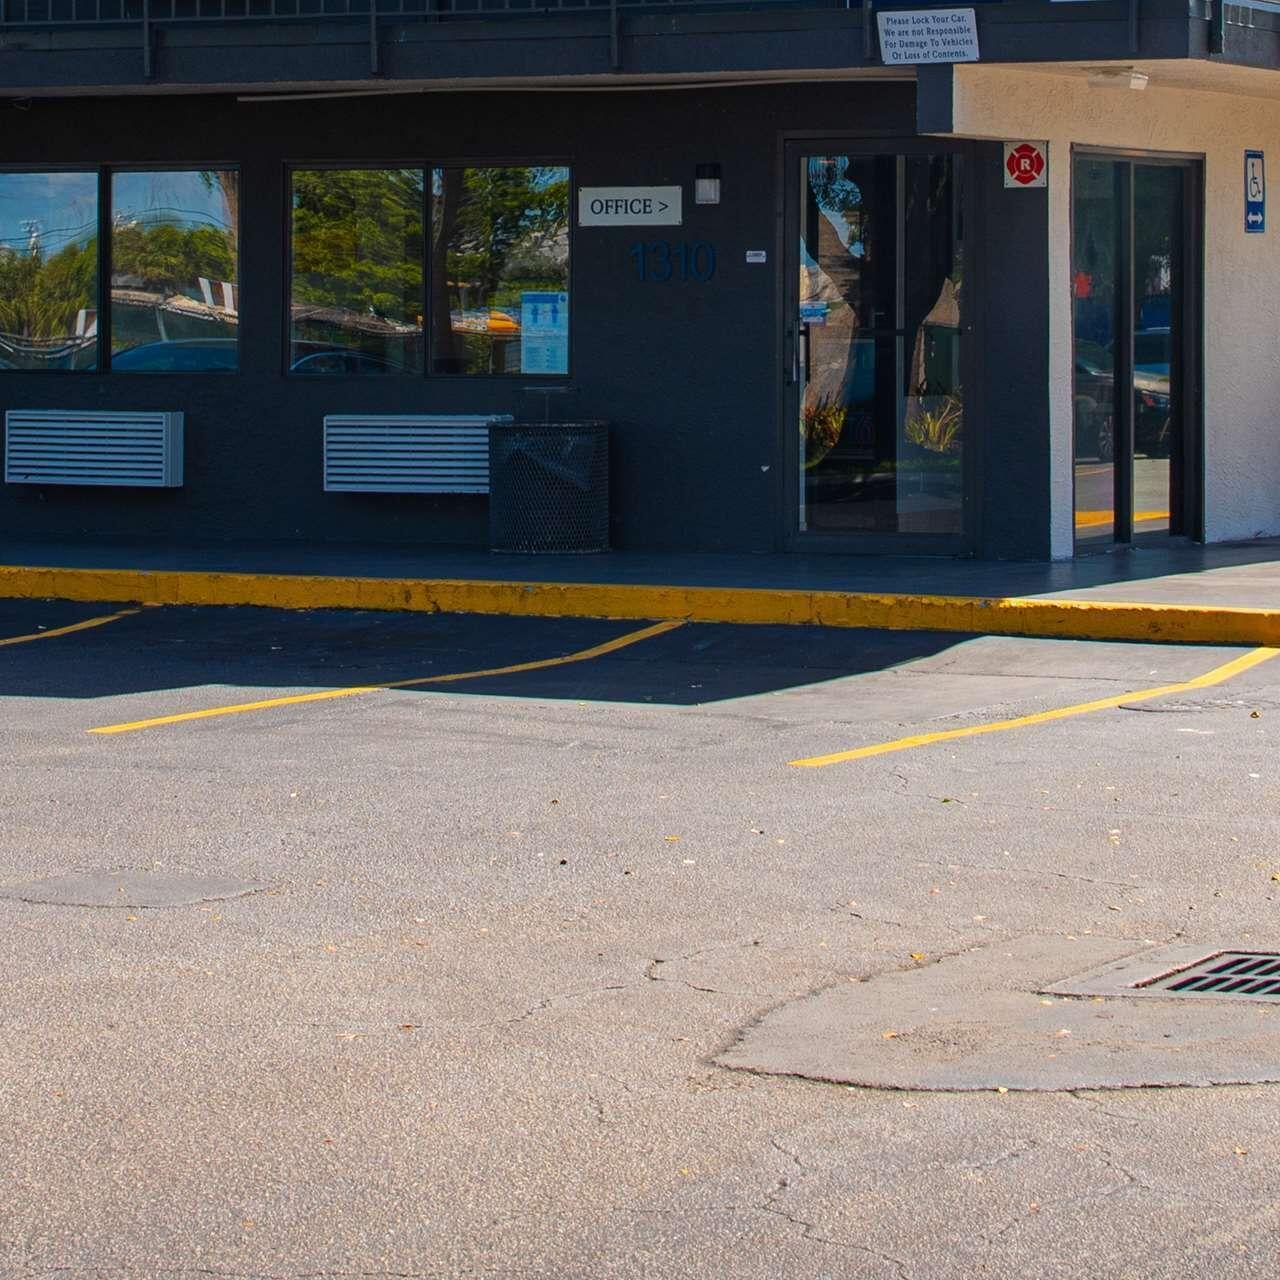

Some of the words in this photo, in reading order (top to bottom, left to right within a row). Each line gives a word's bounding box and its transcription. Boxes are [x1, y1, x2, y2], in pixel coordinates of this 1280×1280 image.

[886, 16, 909, 25] Please
[911, 15, 930, 25] Lock
[931, 15, 949, 24] Your
[884, 28, 895, 37] We
[897, 29, 909, 37] are
[911, 28, 924, 37] not
[926, 26, 971, 37] Responsible
[884, 40, 897, 49] For
[899, 40, 928, 49] Damage
[930, 38, 940, 47] To
[941, 37, 973, 47] Vehicles
[891, 52, 902, 60] Or
[904, 51, 921, 60] Loss
[922, 50, 930, 59] of
[1020, 158, 1031, 171] R
[590, 198, 653, 215] OFFICE
[628, 239, 717, 282] 1310
